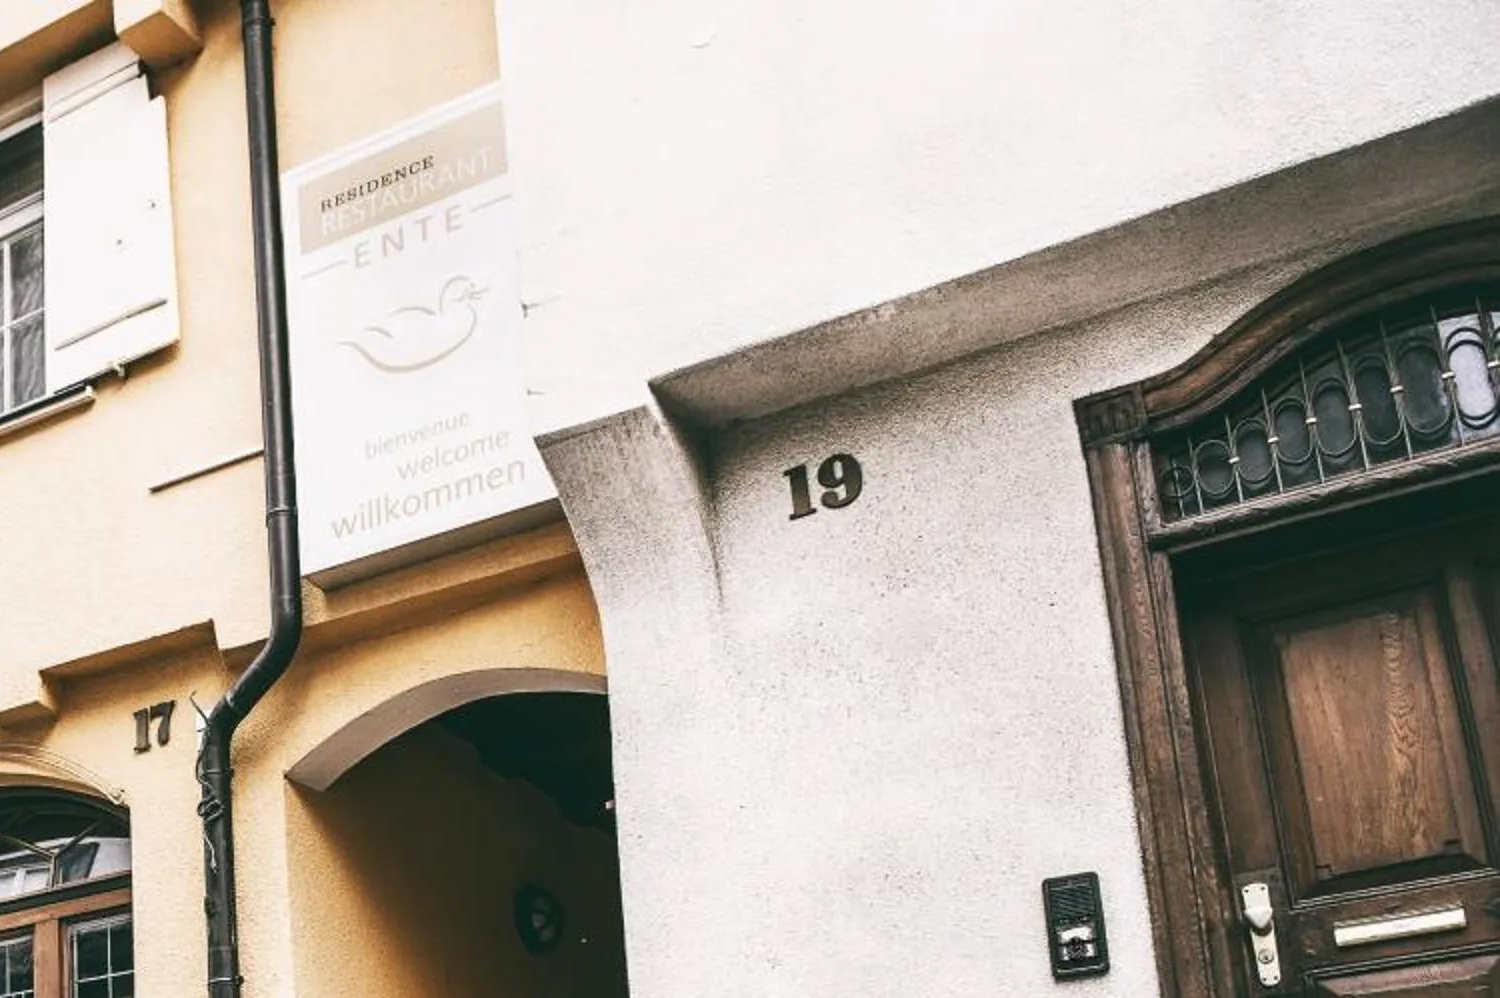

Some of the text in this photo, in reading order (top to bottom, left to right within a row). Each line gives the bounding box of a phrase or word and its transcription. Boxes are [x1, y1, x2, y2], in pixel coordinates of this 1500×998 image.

[321, 155, 435, 212] RESIDENCE
[322, 147, 492, 236] RESTAURANT
[355, 205, 465, 268] ENTE
[366, 411, 470, 460] bienvenue
[397, 429, 510, 480] welcome
[331, 458, 526, 539] willkommen
[783, 453, 862, 520] 19
[133, 699, 177, 755] 17
